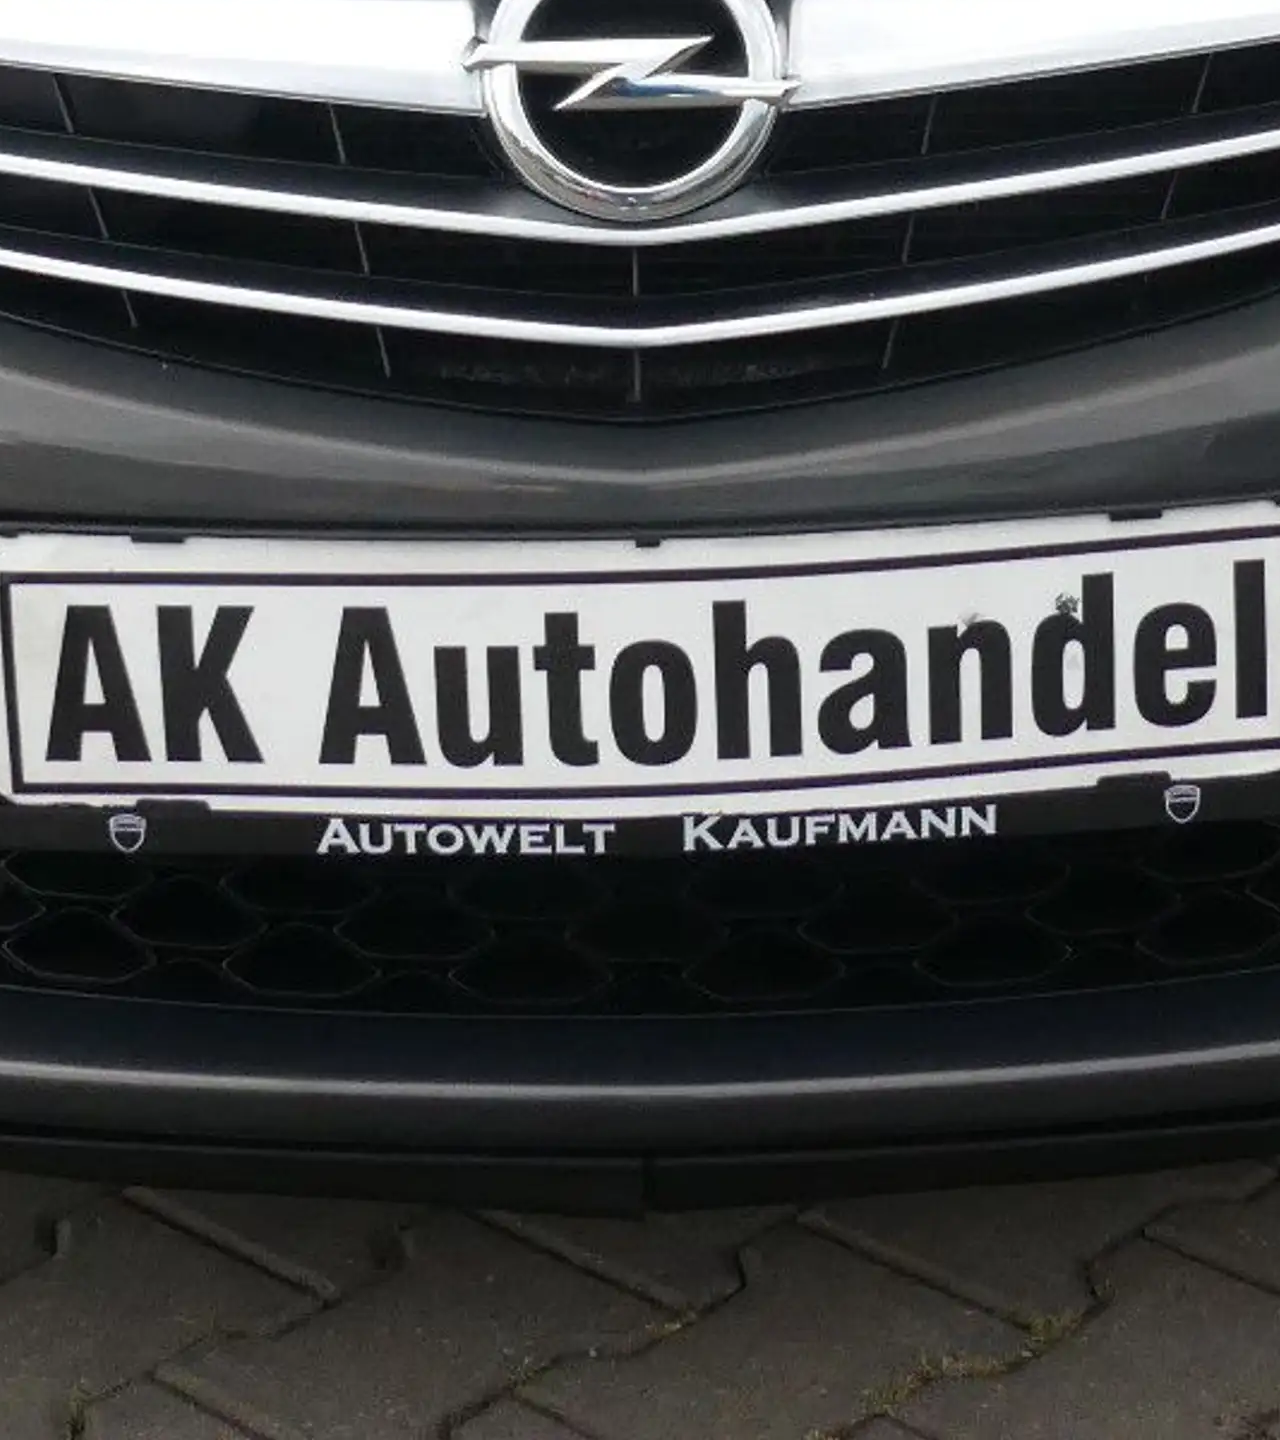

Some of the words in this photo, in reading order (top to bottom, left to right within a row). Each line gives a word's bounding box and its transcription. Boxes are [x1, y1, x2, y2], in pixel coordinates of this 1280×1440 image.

[45, 604, 264, 764] AK
[318, 560, 1269, 768] Autohandel
[317, 816, 617, 856] AUTOWELT
[681, 802, 998, 851] KAUFMANN
